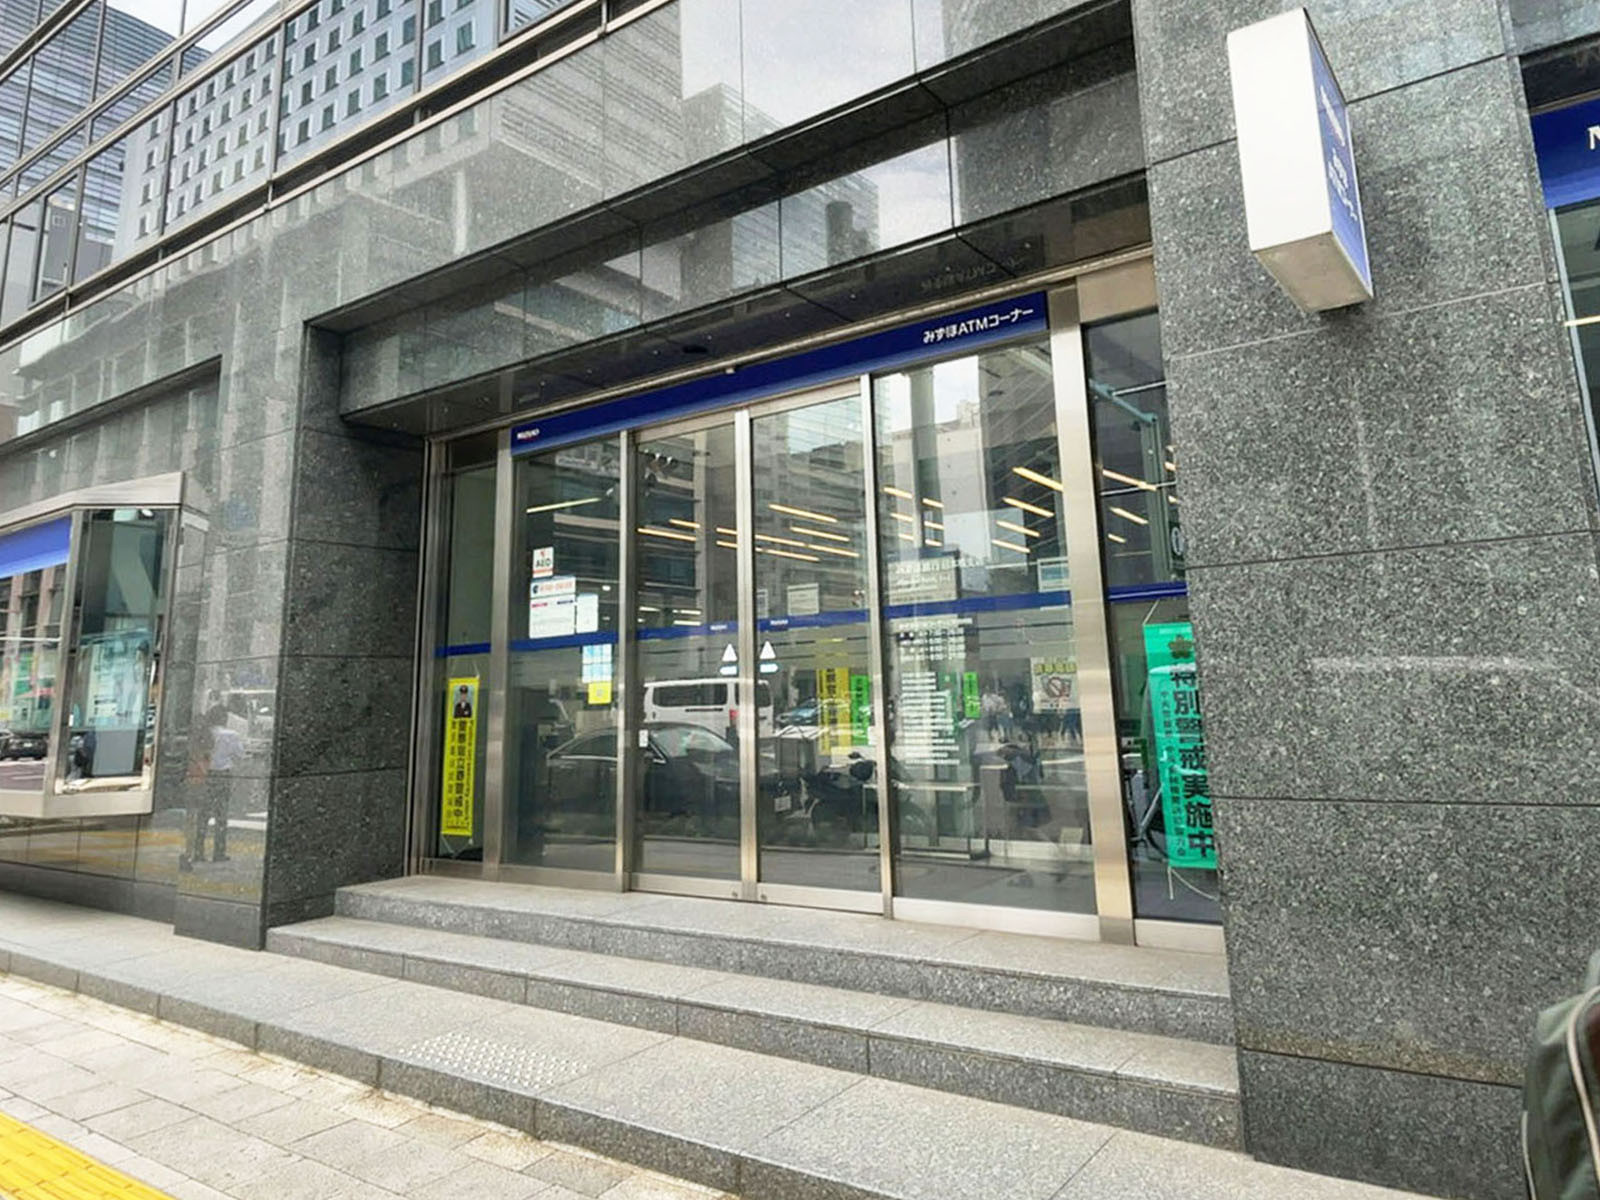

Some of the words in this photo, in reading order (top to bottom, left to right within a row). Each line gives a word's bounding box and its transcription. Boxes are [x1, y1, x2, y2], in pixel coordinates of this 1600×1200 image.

[923, 308, 1034, 343] みずほATMコーナー
